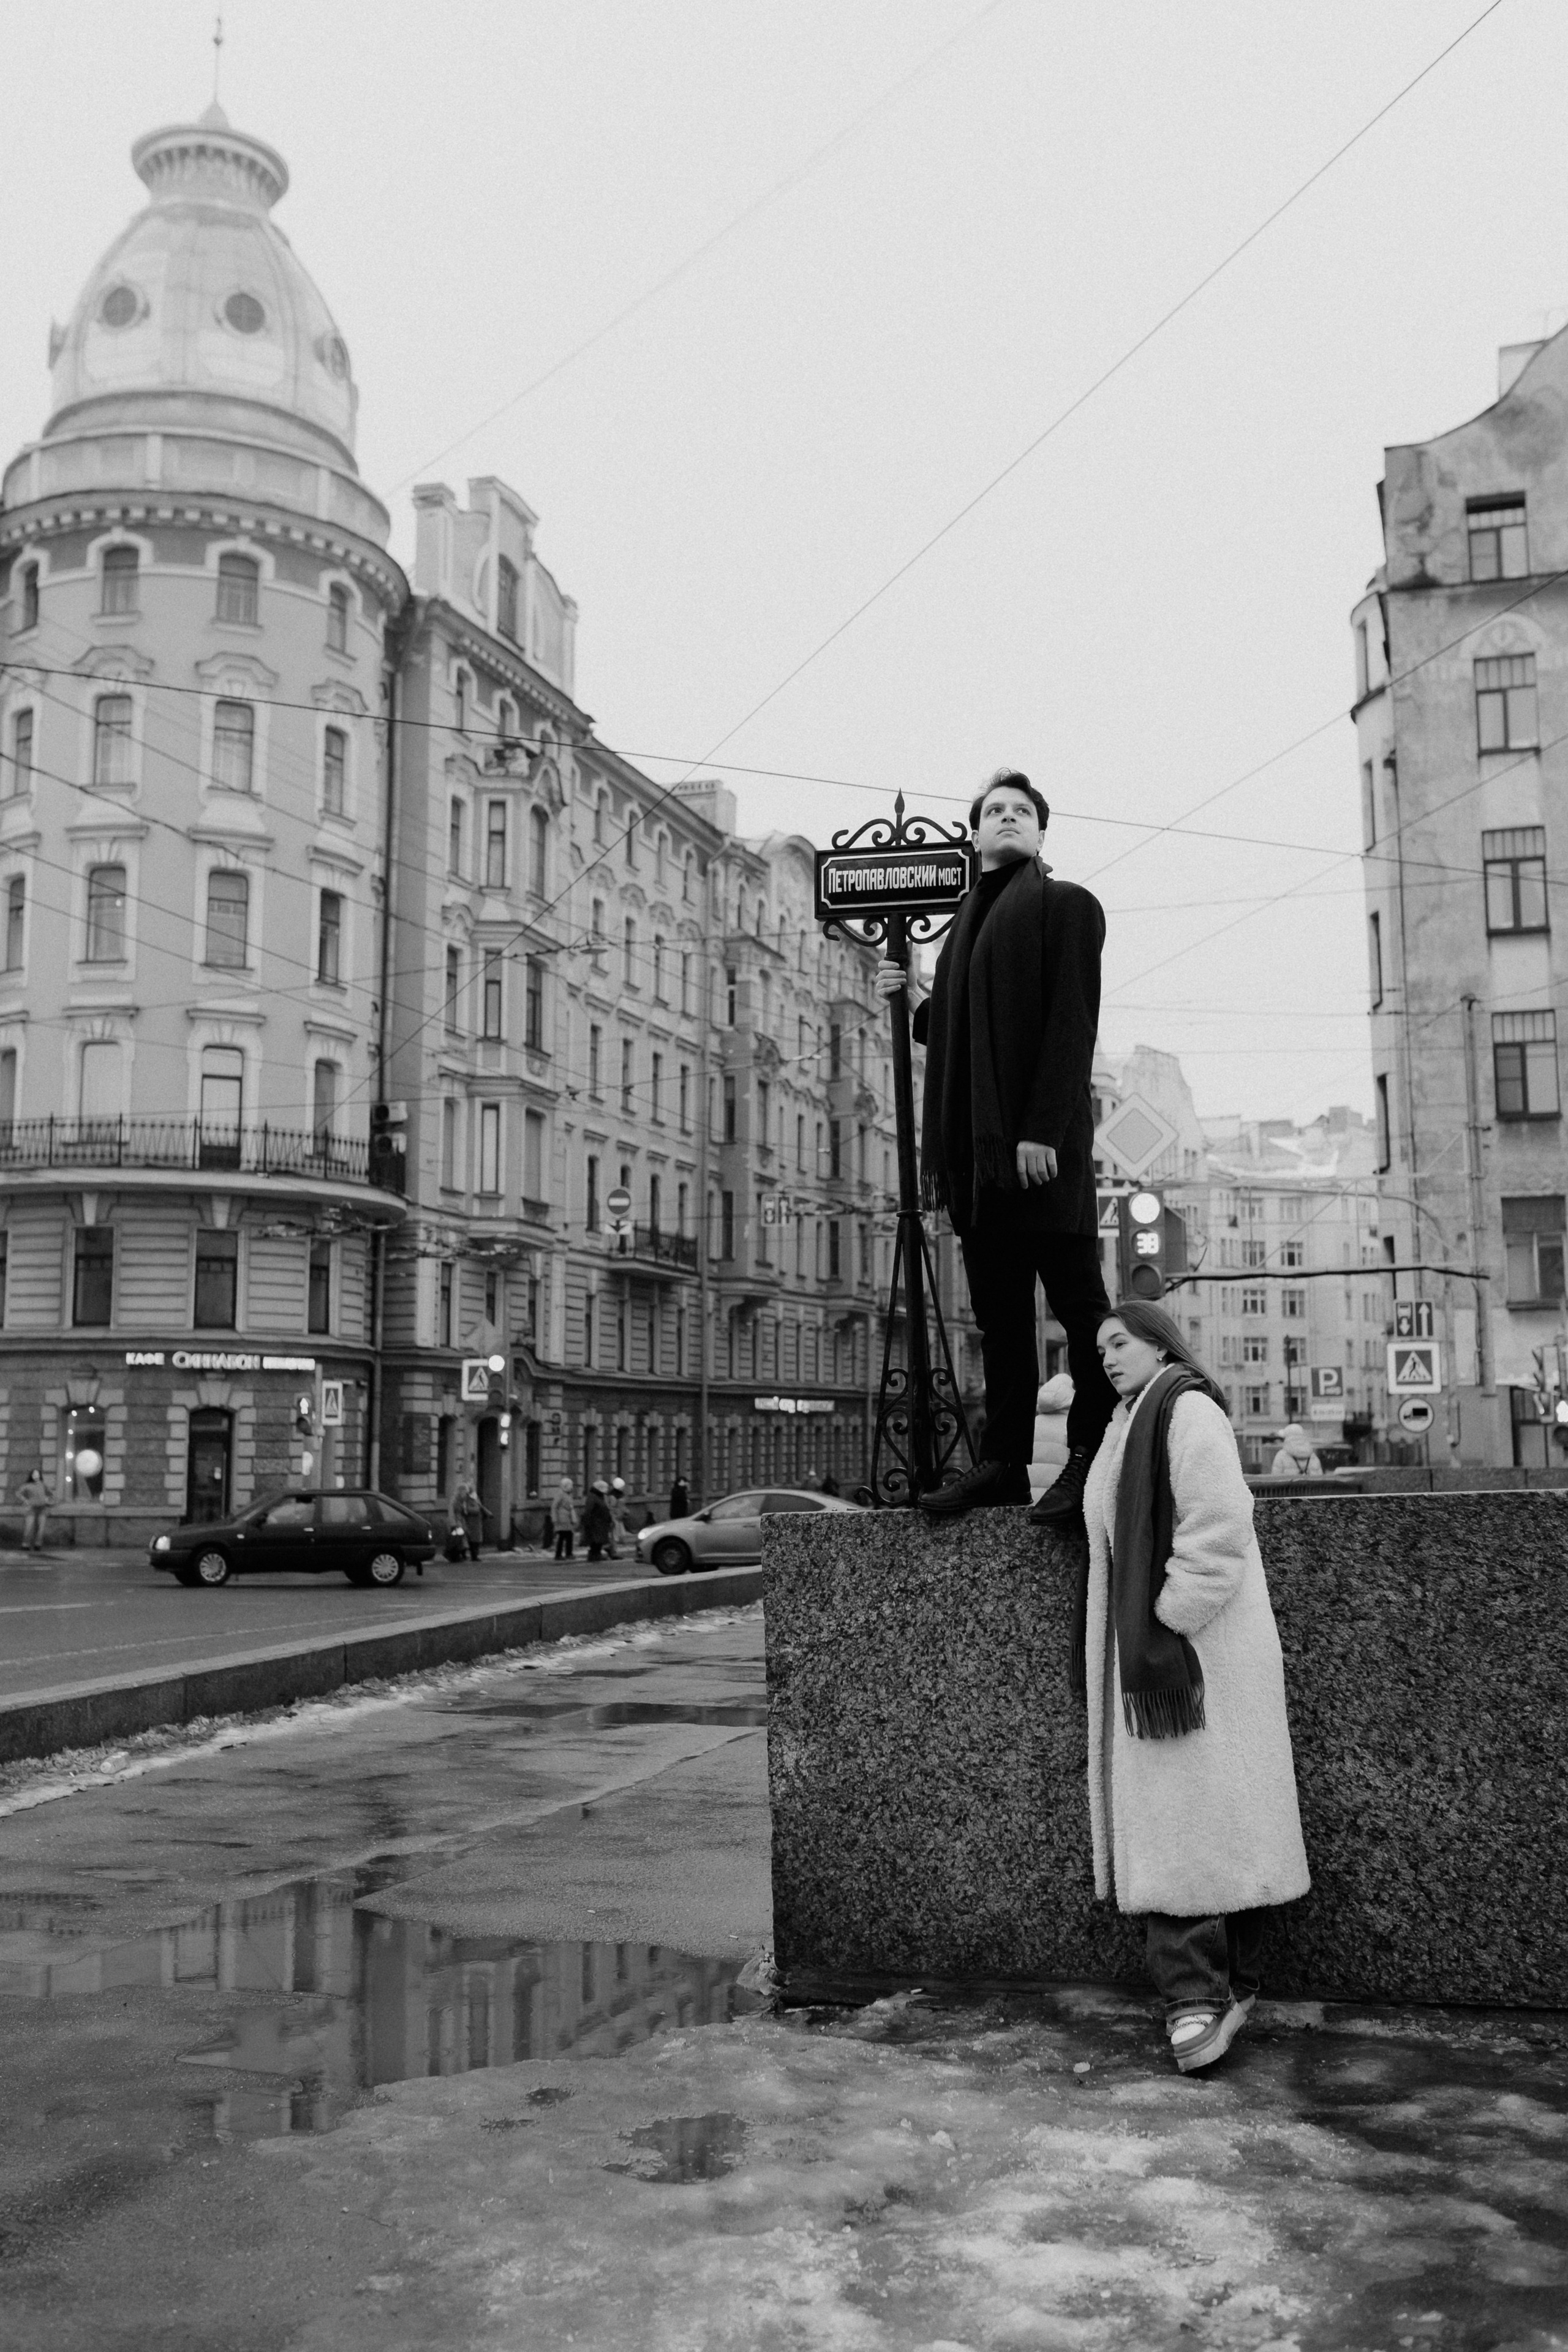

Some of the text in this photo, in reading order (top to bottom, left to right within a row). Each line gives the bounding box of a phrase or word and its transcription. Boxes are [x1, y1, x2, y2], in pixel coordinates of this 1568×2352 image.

[828, 865, 962, 894] ПЕТРОПАВЛОВСКИЙ МОСТ
[1136, 1232, 1159, 1254] 38
